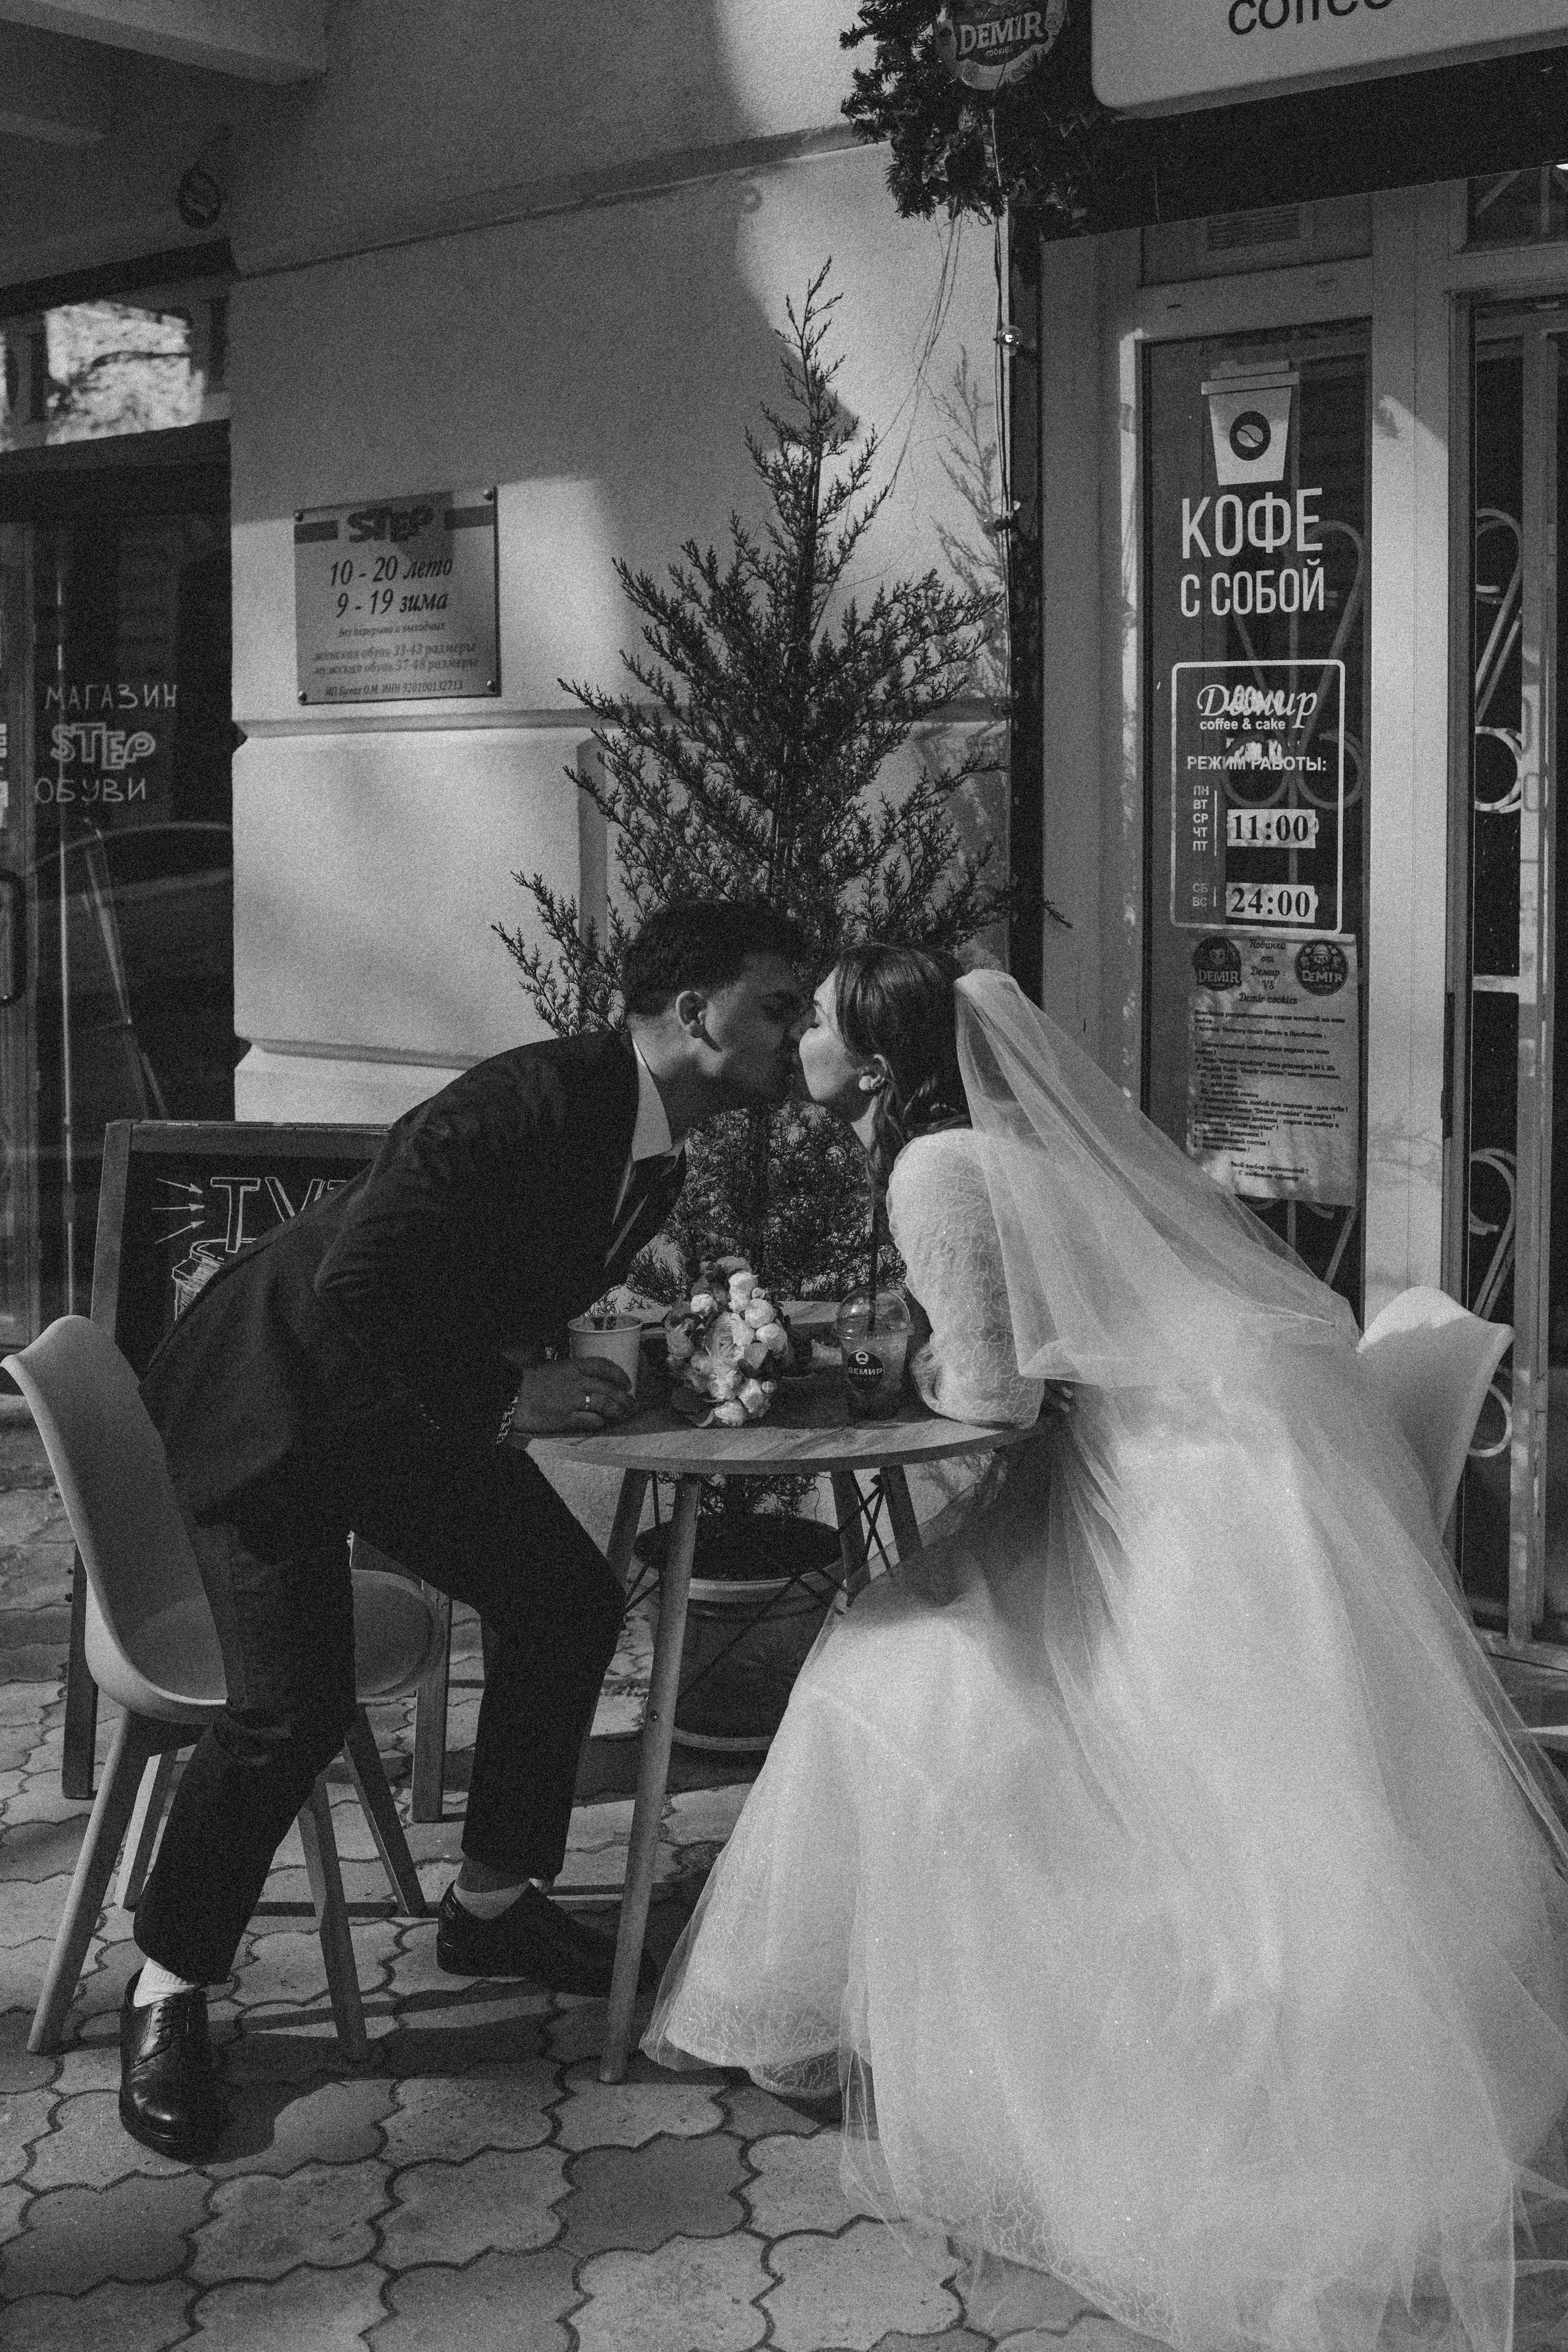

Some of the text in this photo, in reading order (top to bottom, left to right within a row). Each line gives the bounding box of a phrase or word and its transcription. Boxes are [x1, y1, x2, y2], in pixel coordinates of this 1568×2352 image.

[959, 11, 1044, 55] DEMIR
[347, 504, 434, 543] STEP
[1182, 488, 1323, 559] КОФЕ
[331, 559, 353, 586] 10
[372, 555, 398, 582] 20
[402, 559, 453, 579] лето
[1180, 559, 1325, 617] С СОБОЙ
[336, 592, 349, 617] 9
[371, 588, 394, 615] 19
[399, 593, 448, 612] зима
[44, 684, 178, 710] МАГАЗИН
[1199, 717, 1286, 730] coffee & cake
[50, 722, 156, 771] STEP
[1187, 756, 1327, 772] РЕЖИМ РАБОТЫ:
[35, 777, 148, 803] ОБУВИ
[1193, 785, 1210, 796] ПН
[1193, 799, 1208, 810] ВТ
[1193, 813, 1208, 823] СР
[1193, 827, 1208, 837] ЧТ
[1233, 814, 1310, 841] 11:00
[1193, 840, 1208, 851] ПТ
[1192, 897, 1208, 907] ВС
[1231, 886, 1311, 917] 24:00
[1250, 939, 1286, 950] Новинка
[1198, 969, 1240, 984] DEMIR
[1302, 970, 1343, 983] DEMIR
[1239, 992, 1298, 1005] Demir cookies
[210, 1177, 349, 1253] TV
[848, 1366, 883, 1376] ДЕМИР
